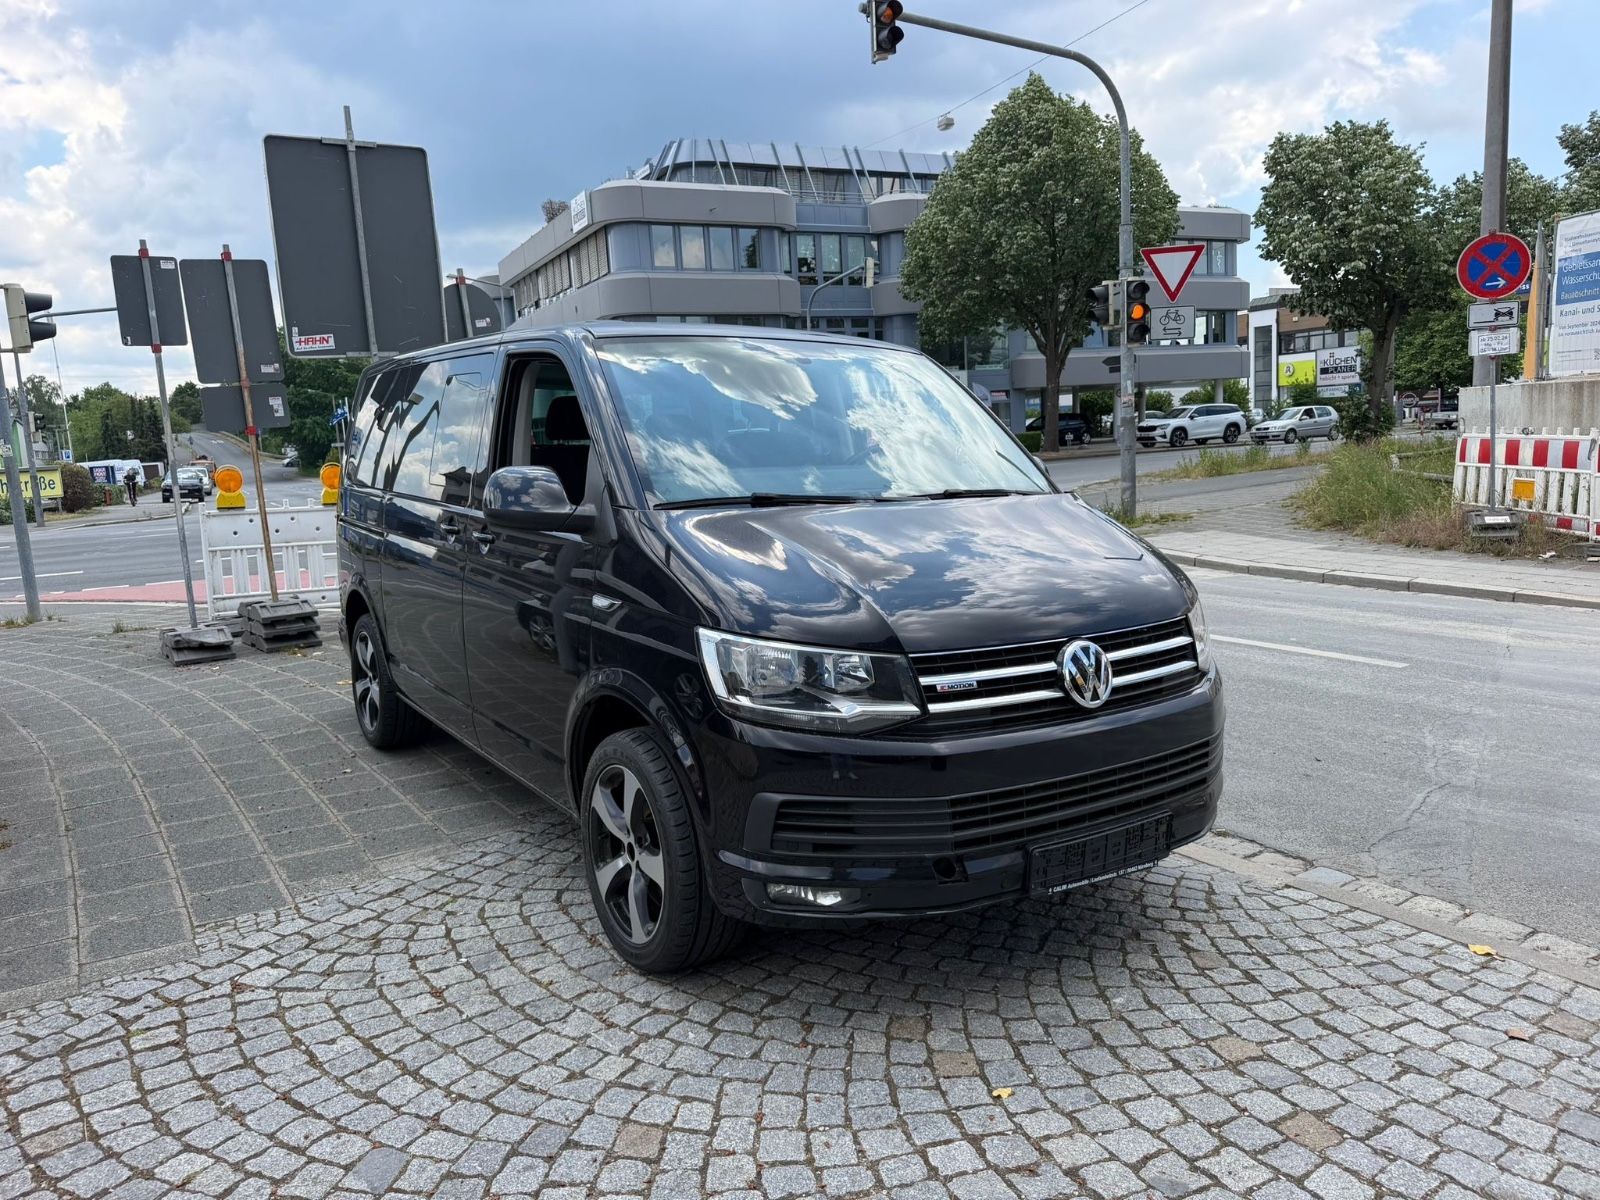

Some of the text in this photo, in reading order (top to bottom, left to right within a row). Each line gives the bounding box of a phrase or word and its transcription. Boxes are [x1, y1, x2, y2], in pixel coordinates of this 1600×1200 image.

[1581, 305, 1595, 315] und
[1323, 353, 1357, 366] KÜCHEN
[1328, 365, 1357, 374] PLANER
